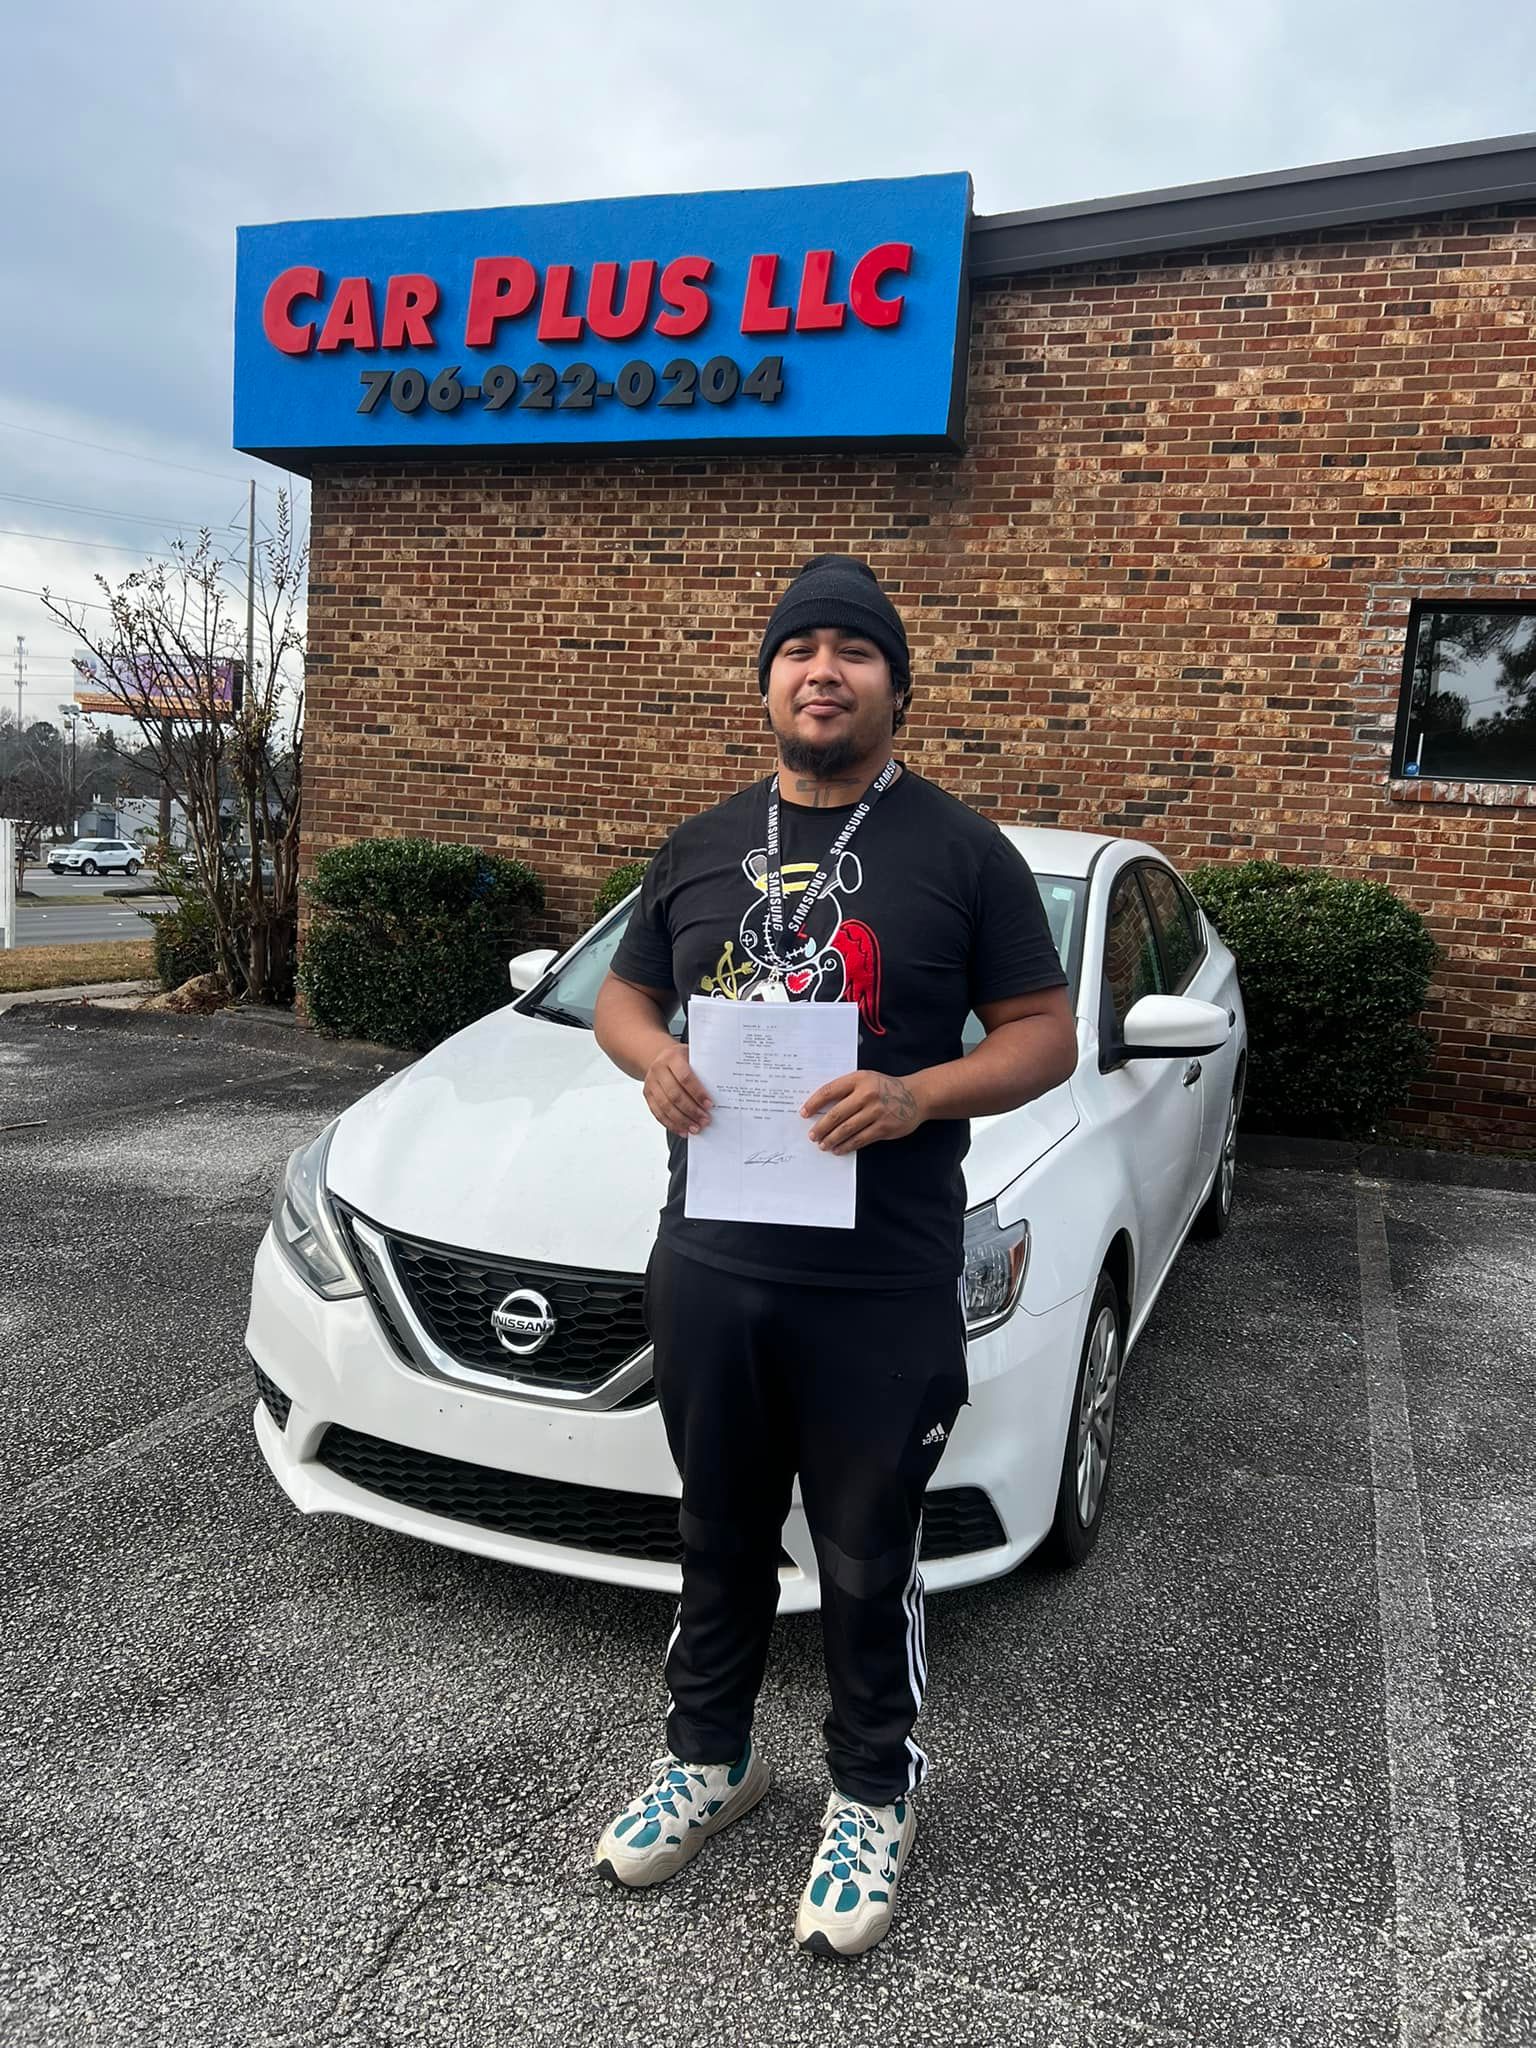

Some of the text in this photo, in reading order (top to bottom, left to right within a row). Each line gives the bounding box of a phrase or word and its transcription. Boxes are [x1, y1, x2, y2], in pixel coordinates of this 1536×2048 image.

[263, 243, 913, 354] CAR PLUS LLC
[357, 355, 784, 414] 706-922-0204
[768, 804, 779, 856] SAMSUNG
[830, 802, 870, 856] SAMSUNG
[768, 871, 784, 932] SAMSUNG
[788, 871, 827, 932] SAMSUNG
[494, 1314, 547, 1332] NISSAN
